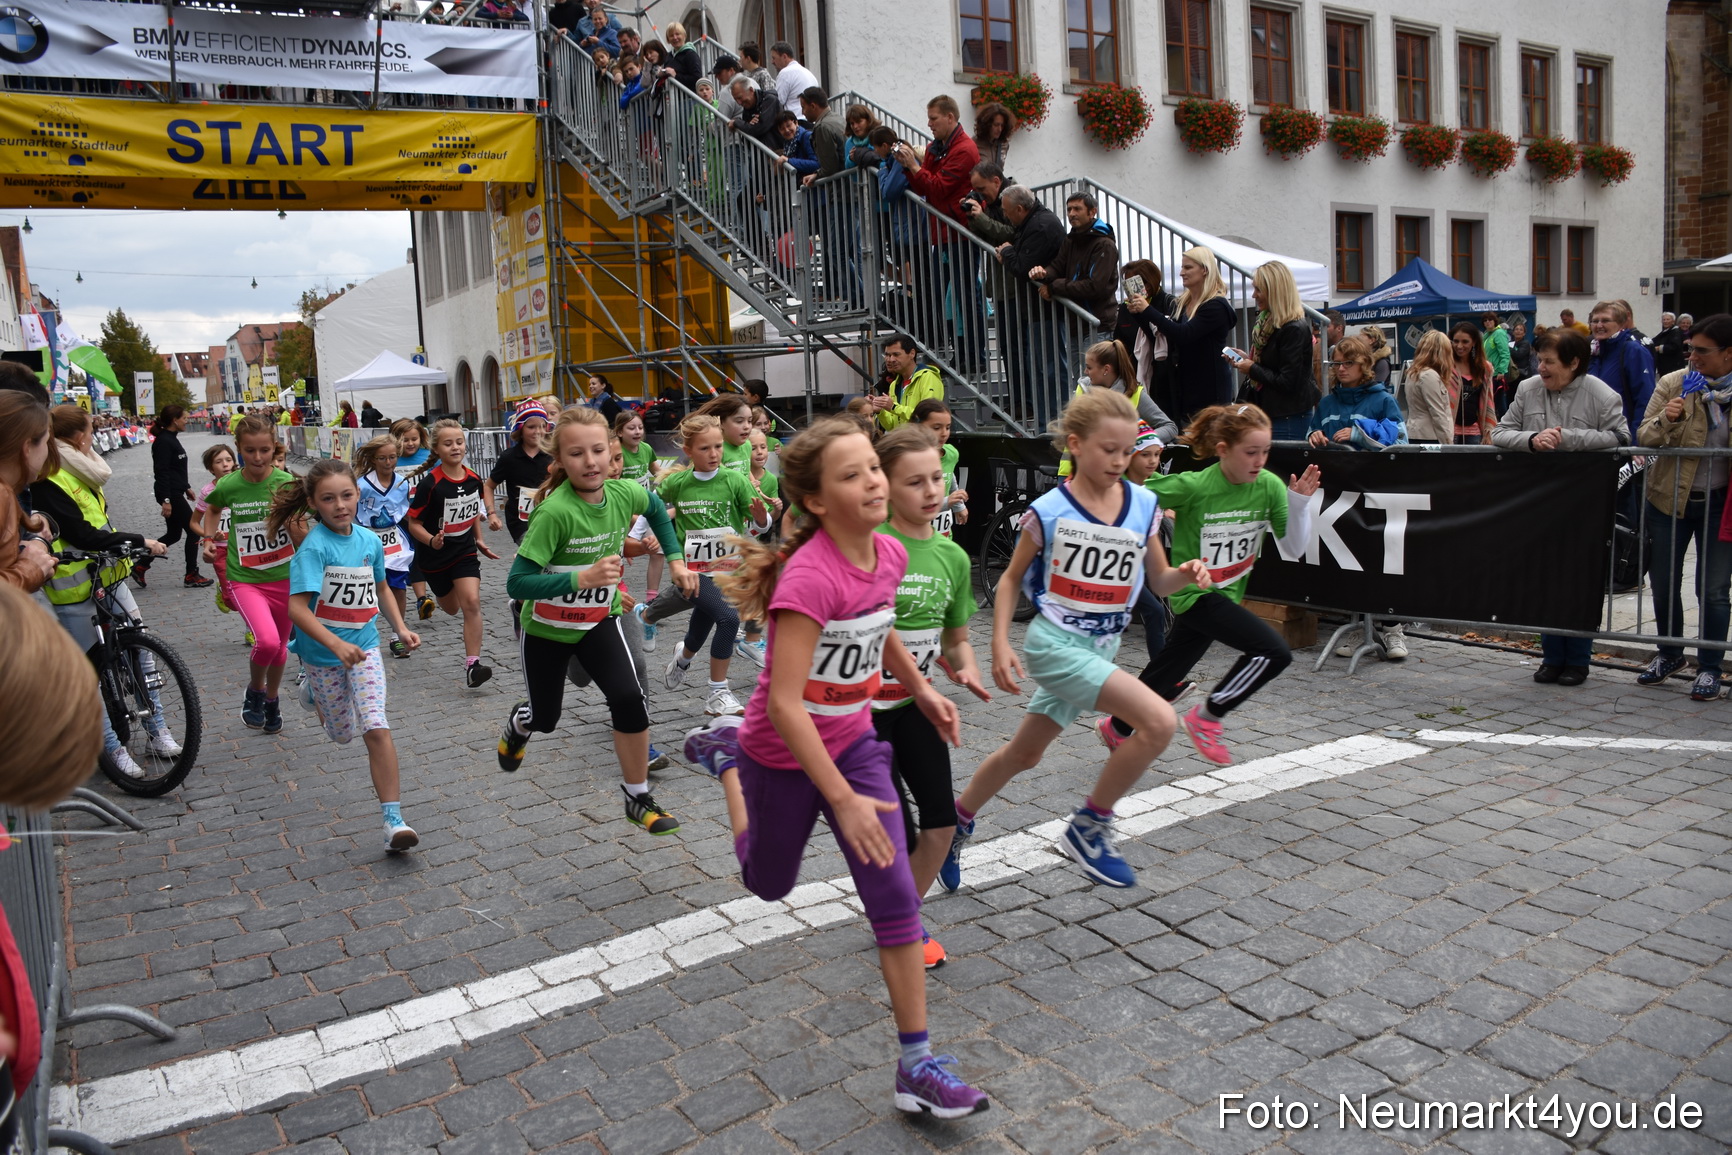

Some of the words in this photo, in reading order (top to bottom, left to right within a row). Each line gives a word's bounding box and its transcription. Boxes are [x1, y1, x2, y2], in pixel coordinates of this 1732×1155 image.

[6, 7, 42, 27] MW
[133, 27, 190, 47] BMW
[134, 49, 200, 63] WENIGER
[201, 53, 287, 68] VERBRAUCH.
[289, 58, 327, 70] MEHR
[329, 60, 413, 73] FAHRFREUDE.
[0, 137, 67, 149] eumarkter
[71, 140, 130, 152] Stadtlauf
[166, 118, 364, 166] START
[397, 149, 459, 160] Neumarkter
[461, 150, 508, 160] Stadtlauf
[3, 176, 74, 188] Neumarkter
[75, 178, 126, 189] Stadtlauf
[365, 185, 422, 193] Neumarkter
[1341, 310, 1378, 320] umarkter
[1379, 306, 1413, 318] Tagblatt
[1468, 301, 1499, 311] Neumarkter
[267, 389, 277, 399] A
[79, 400, 89, 410] A
[450, 501, 479, 523] 7429
[1204, 510, 1251, 520] Neumarkter
[381, 531, 397, 546] 98
[568, 532, 610, 545] Neumarkter
[1057, 528, 1089, 541] PARTL
[1092, 534, 1134, 546] Neumarkt
[1295, 487, 1431, 575] KT
[1209, 534, 1257, 565] 7131
[1063, 542, 1135, 582] 7026
[325, 571, 349, 579] PARTL
[902, 573, 933, 583] arkter
[328, 582, 374, 606] 7575
[562, 587, 609, 604] 046
[896, 585, 922, 597] tlauf
[1070, 584, 1114, 601] Theresa
[560, 611, 586, 620] Lena
